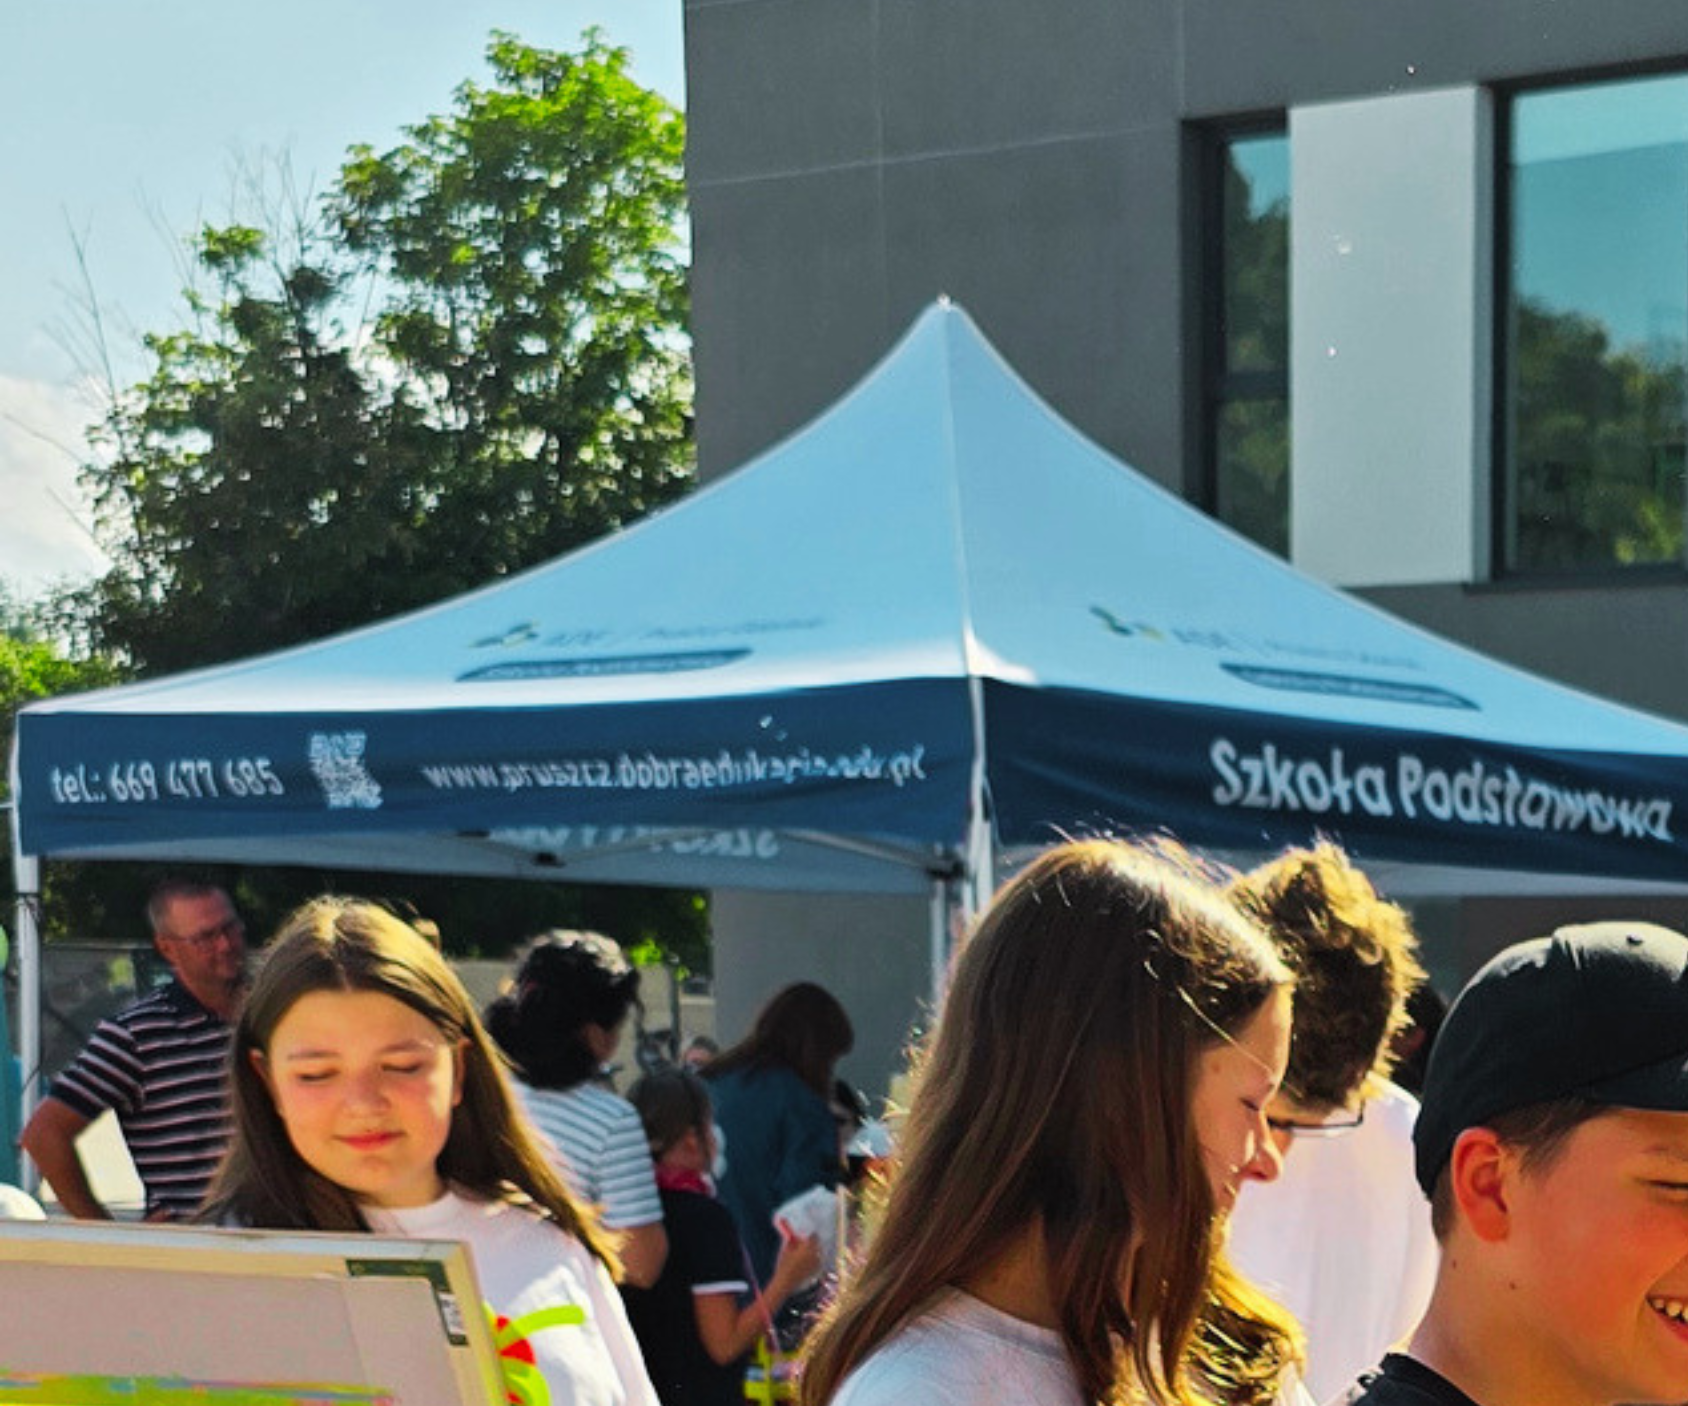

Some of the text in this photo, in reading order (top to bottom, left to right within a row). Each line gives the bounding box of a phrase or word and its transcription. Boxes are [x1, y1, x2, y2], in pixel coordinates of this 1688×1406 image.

[51, 757, 284, 802] tel.: 669 477 685
[1210, 738, 1675, 843] Szkoła Podstawowa
